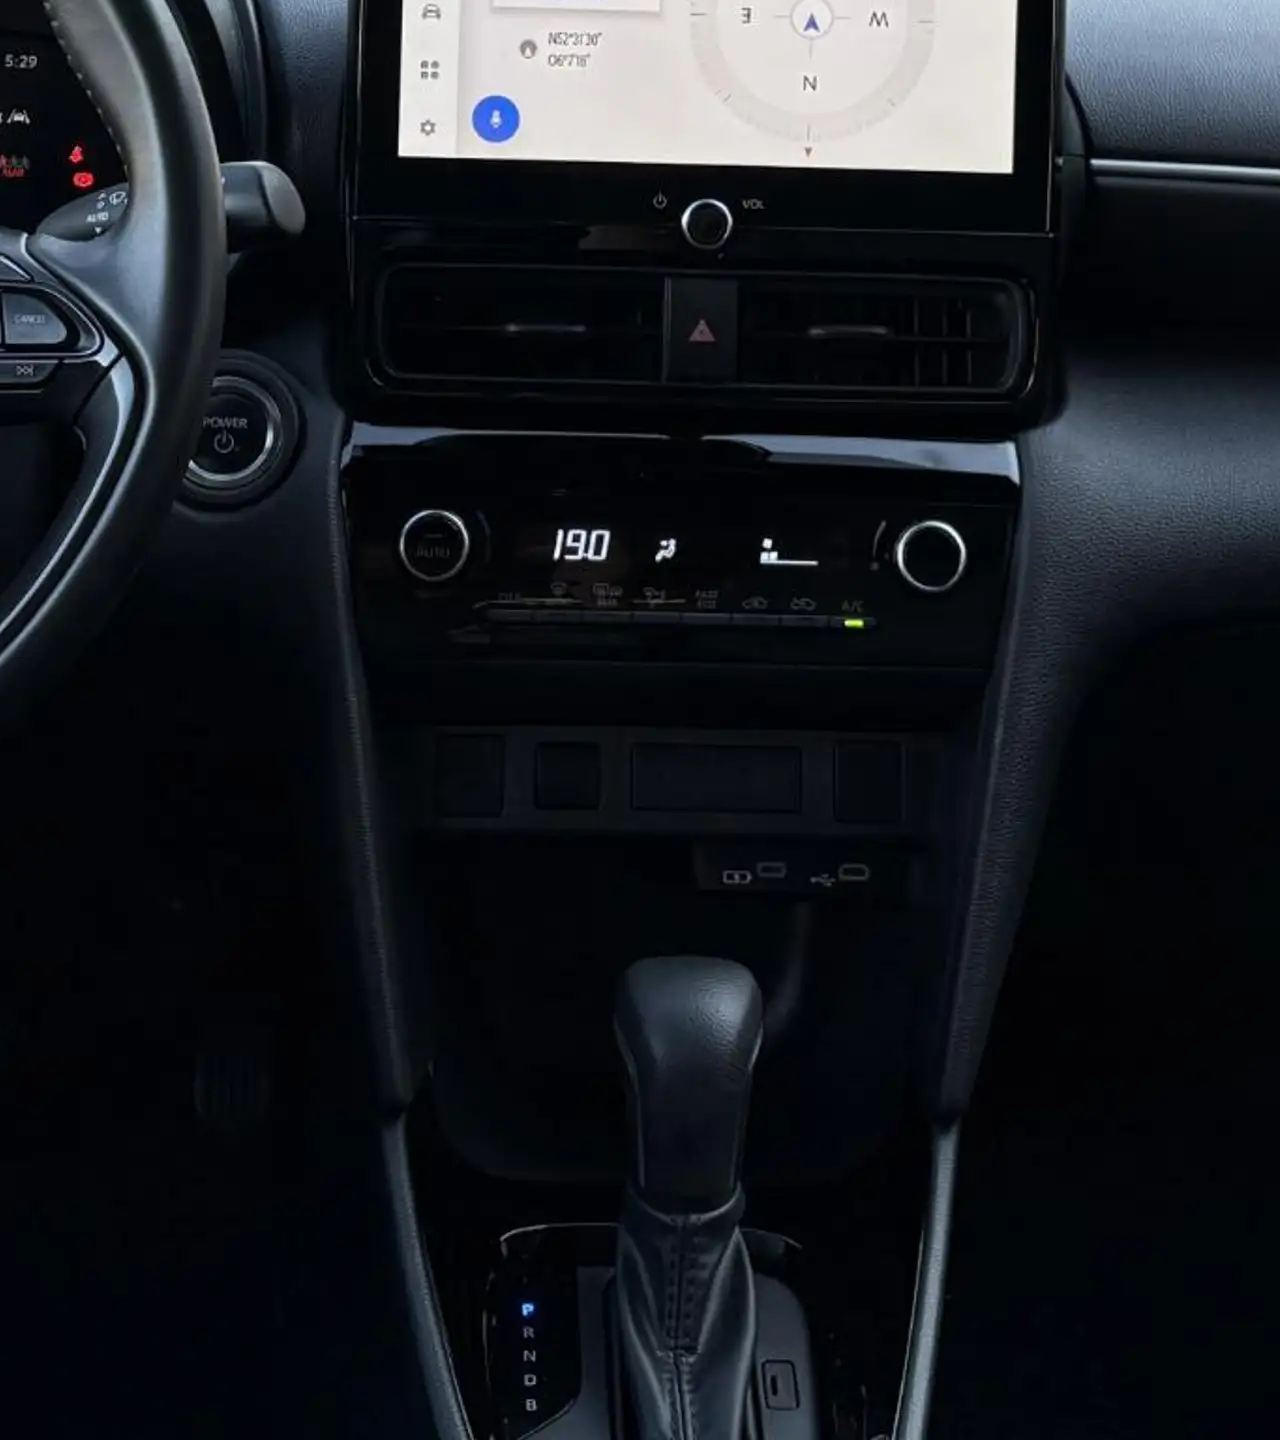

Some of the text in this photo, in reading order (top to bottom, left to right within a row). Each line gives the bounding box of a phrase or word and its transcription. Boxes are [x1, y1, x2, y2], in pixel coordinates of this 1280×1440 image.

[4, 54, 38, 69] 5:29
[802, 74, 818, 91] N
[742, 199, 765, 210] VOL
[202, 416, 249, 429] POWER
[416, 541, 451, 558] AUTO
[841, 598, 864, 612] A/C
[521, 1302, 535, 1317] P
[523, 1326, 535, 1339] R
[523, 1349, 536, 1362] N
[523, 1373, 537, 1387] D
[525, 1398, 538, 1411] B
